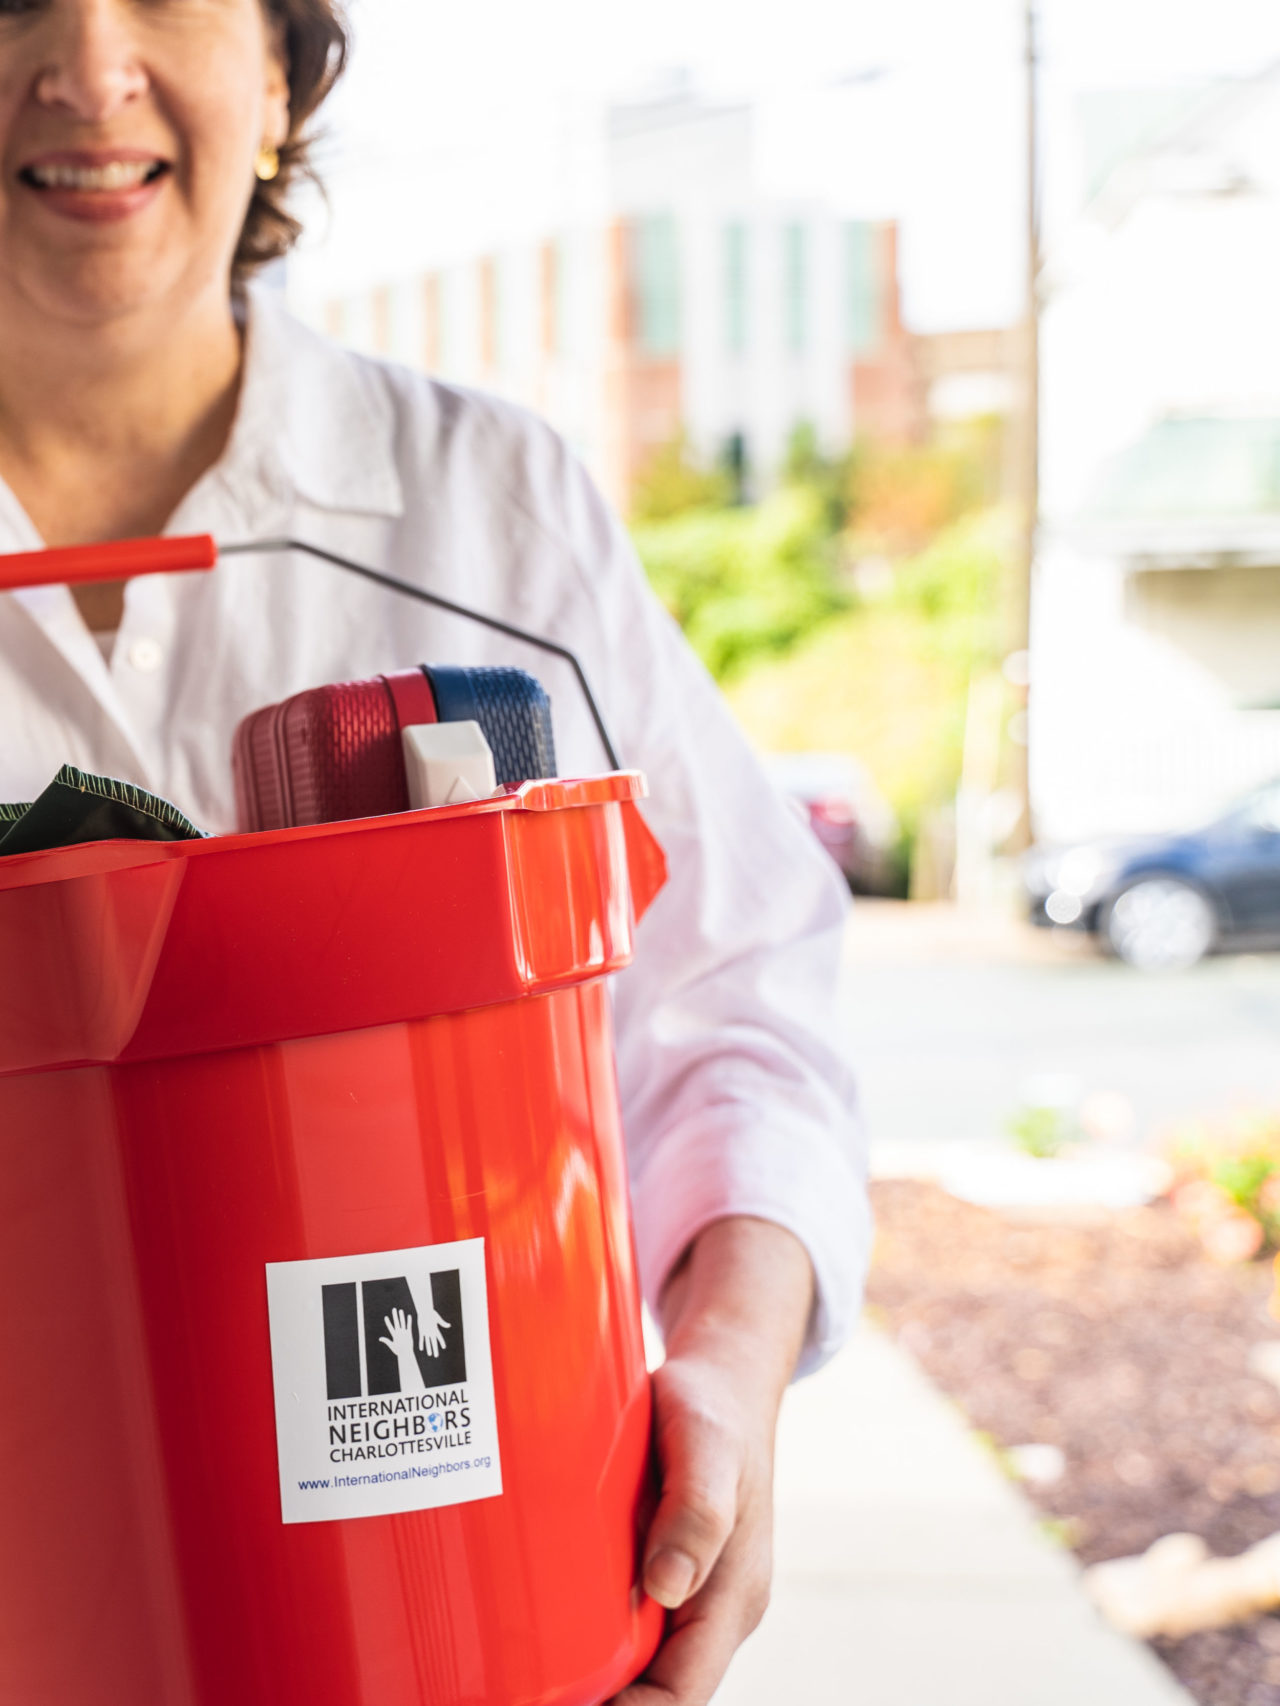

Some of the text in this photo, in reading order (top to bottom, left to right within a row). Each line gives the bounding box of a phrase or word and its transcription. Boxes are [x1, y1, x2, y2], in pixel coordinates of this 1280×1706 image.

[327, 1389, 469, 1421] INTERNATIONAL
[329, 1431, 472, 1463] CHARLOTTESVILLE
[298, 1456, 491, 1490] www.InternationalNeighbors.org
